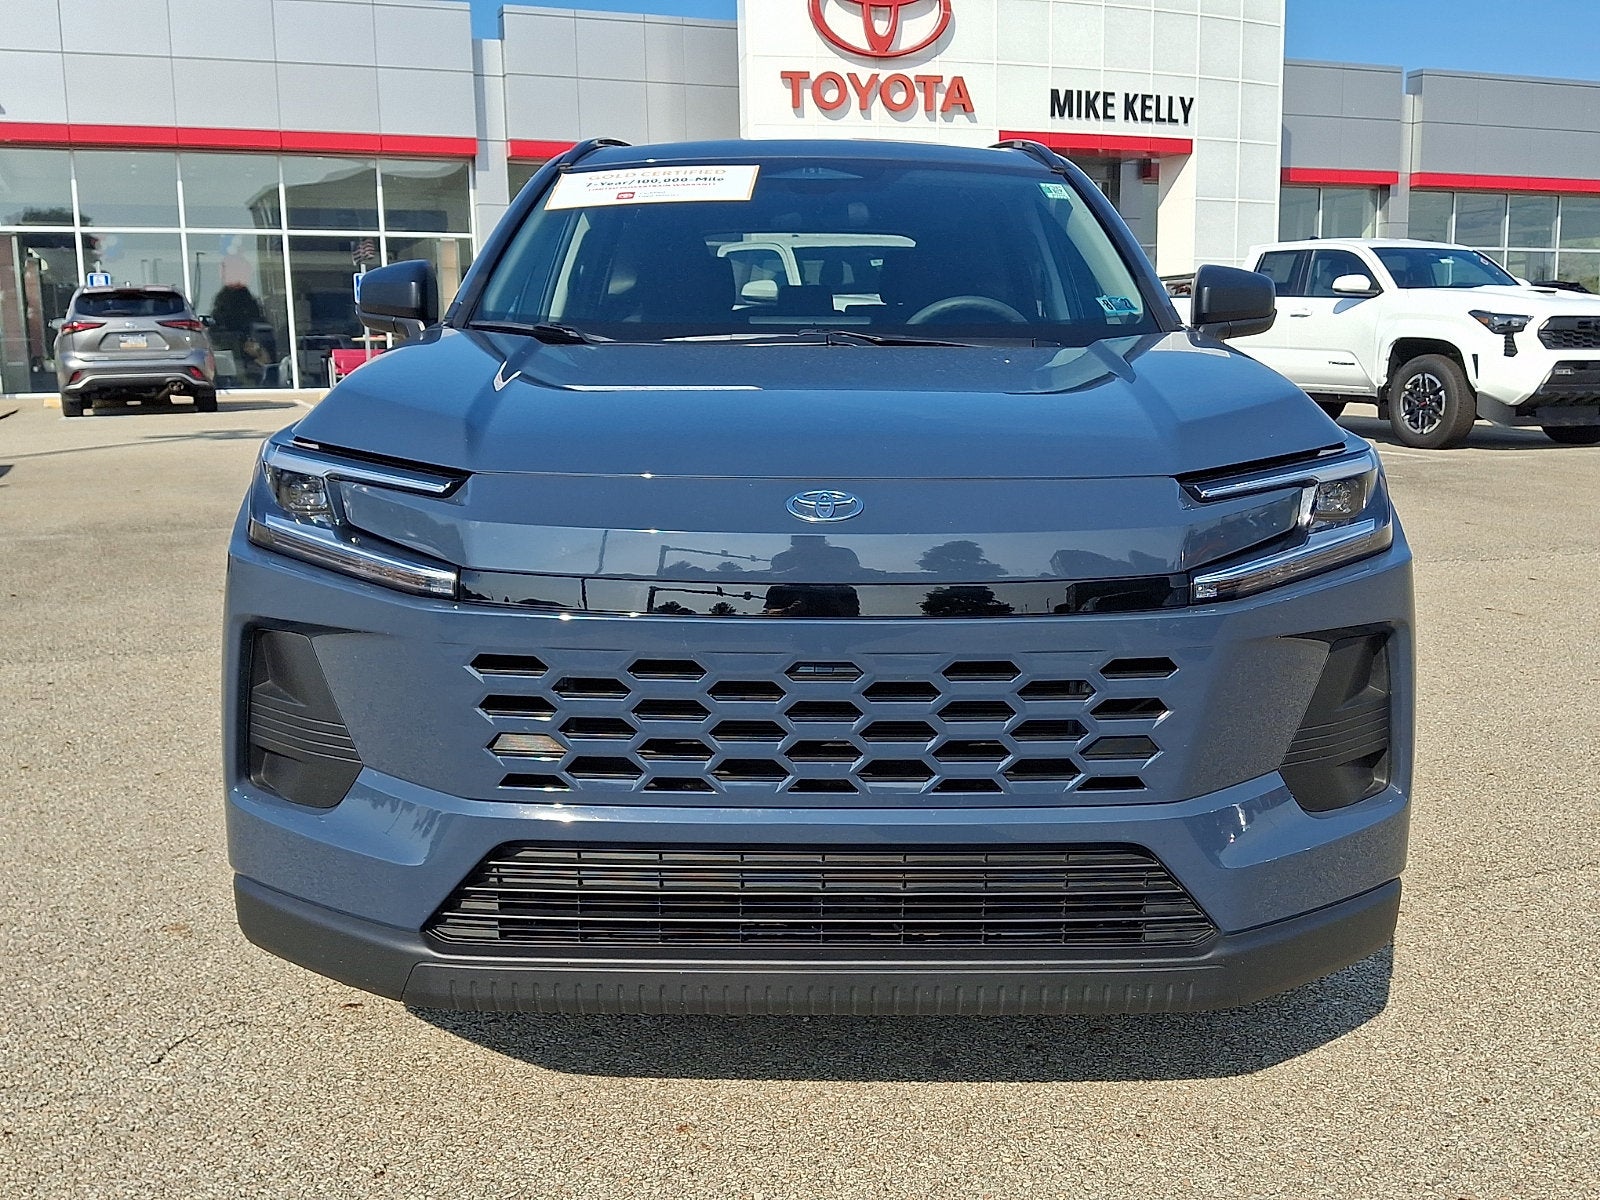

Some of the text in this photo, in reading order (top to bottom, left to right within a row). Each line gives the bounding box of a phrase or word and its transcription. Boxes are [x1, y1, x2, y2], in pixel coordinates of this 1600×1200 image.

[780, 71, 975, 113] TOYOTA
[1050, 88, 1195, 124] MIKE KELLY
[588, 169, 727, 180] GOLD CERTIFIED
